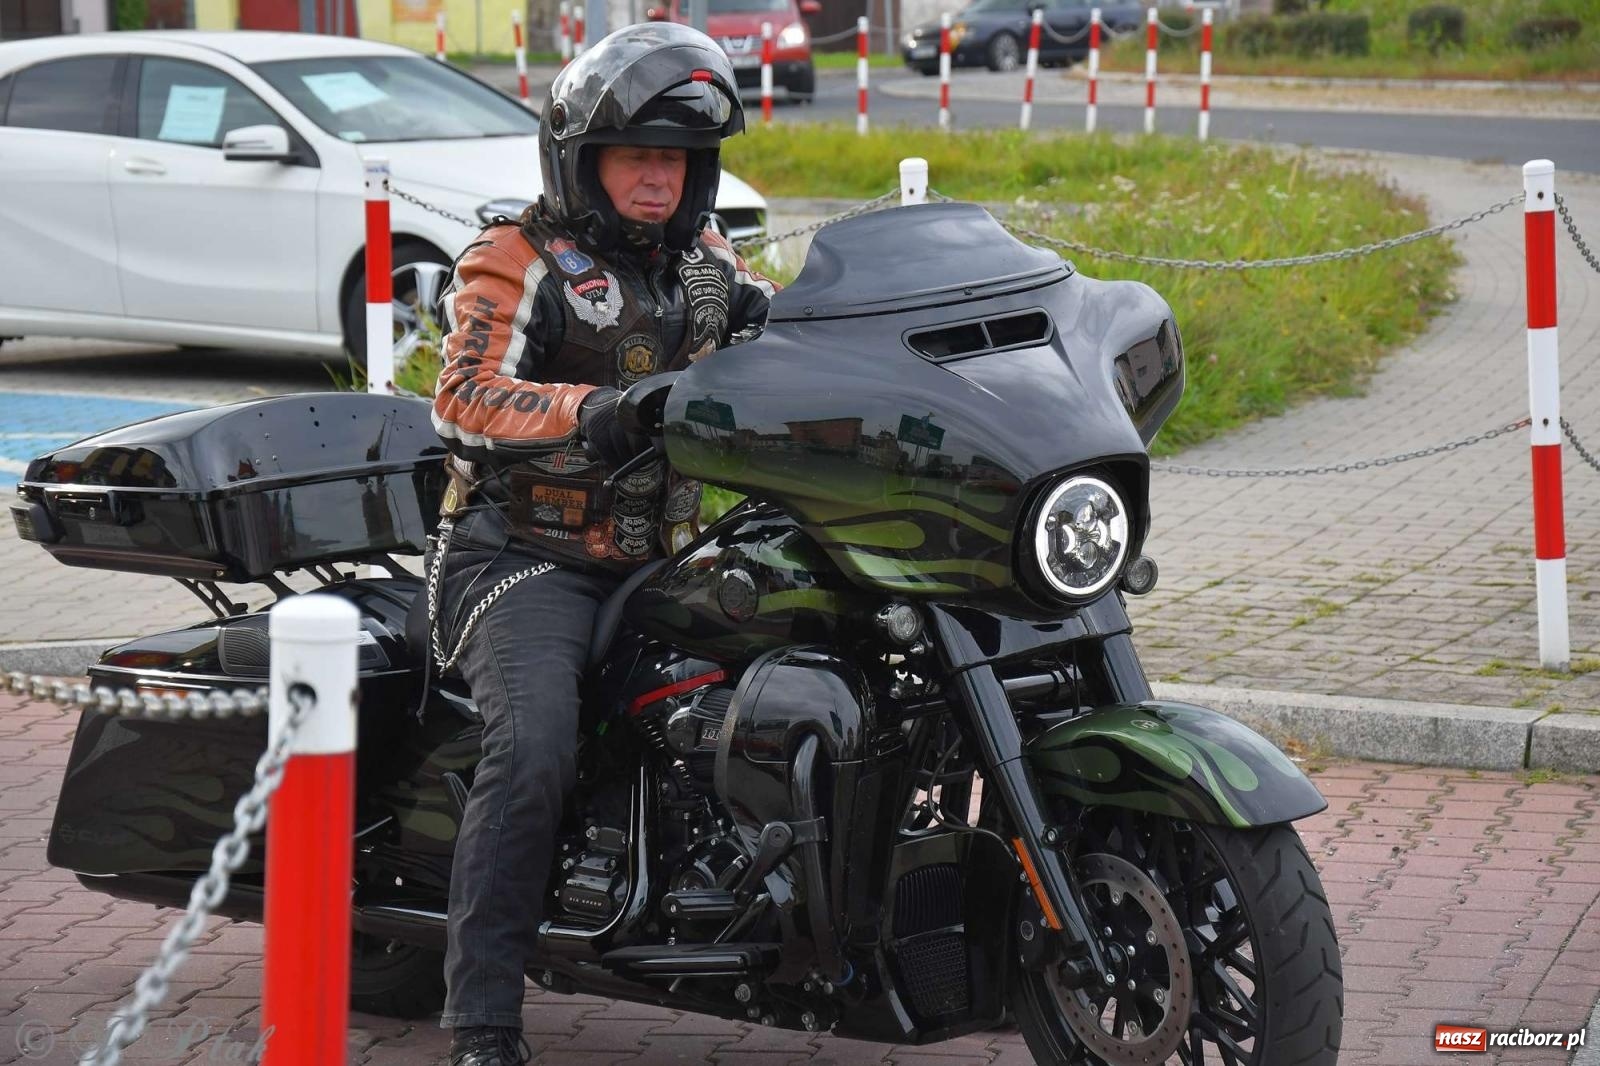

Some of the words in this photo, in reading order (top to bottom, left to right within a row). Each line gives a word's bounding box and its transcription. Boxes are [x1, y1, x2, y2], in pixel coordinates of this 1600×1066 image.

[577, 279, 607, 294] PRUDNIK
[544, 488, 574, 499] DUAL
[544, 528, 569, 540] 2011
[702, 727, 722, 741] 11
